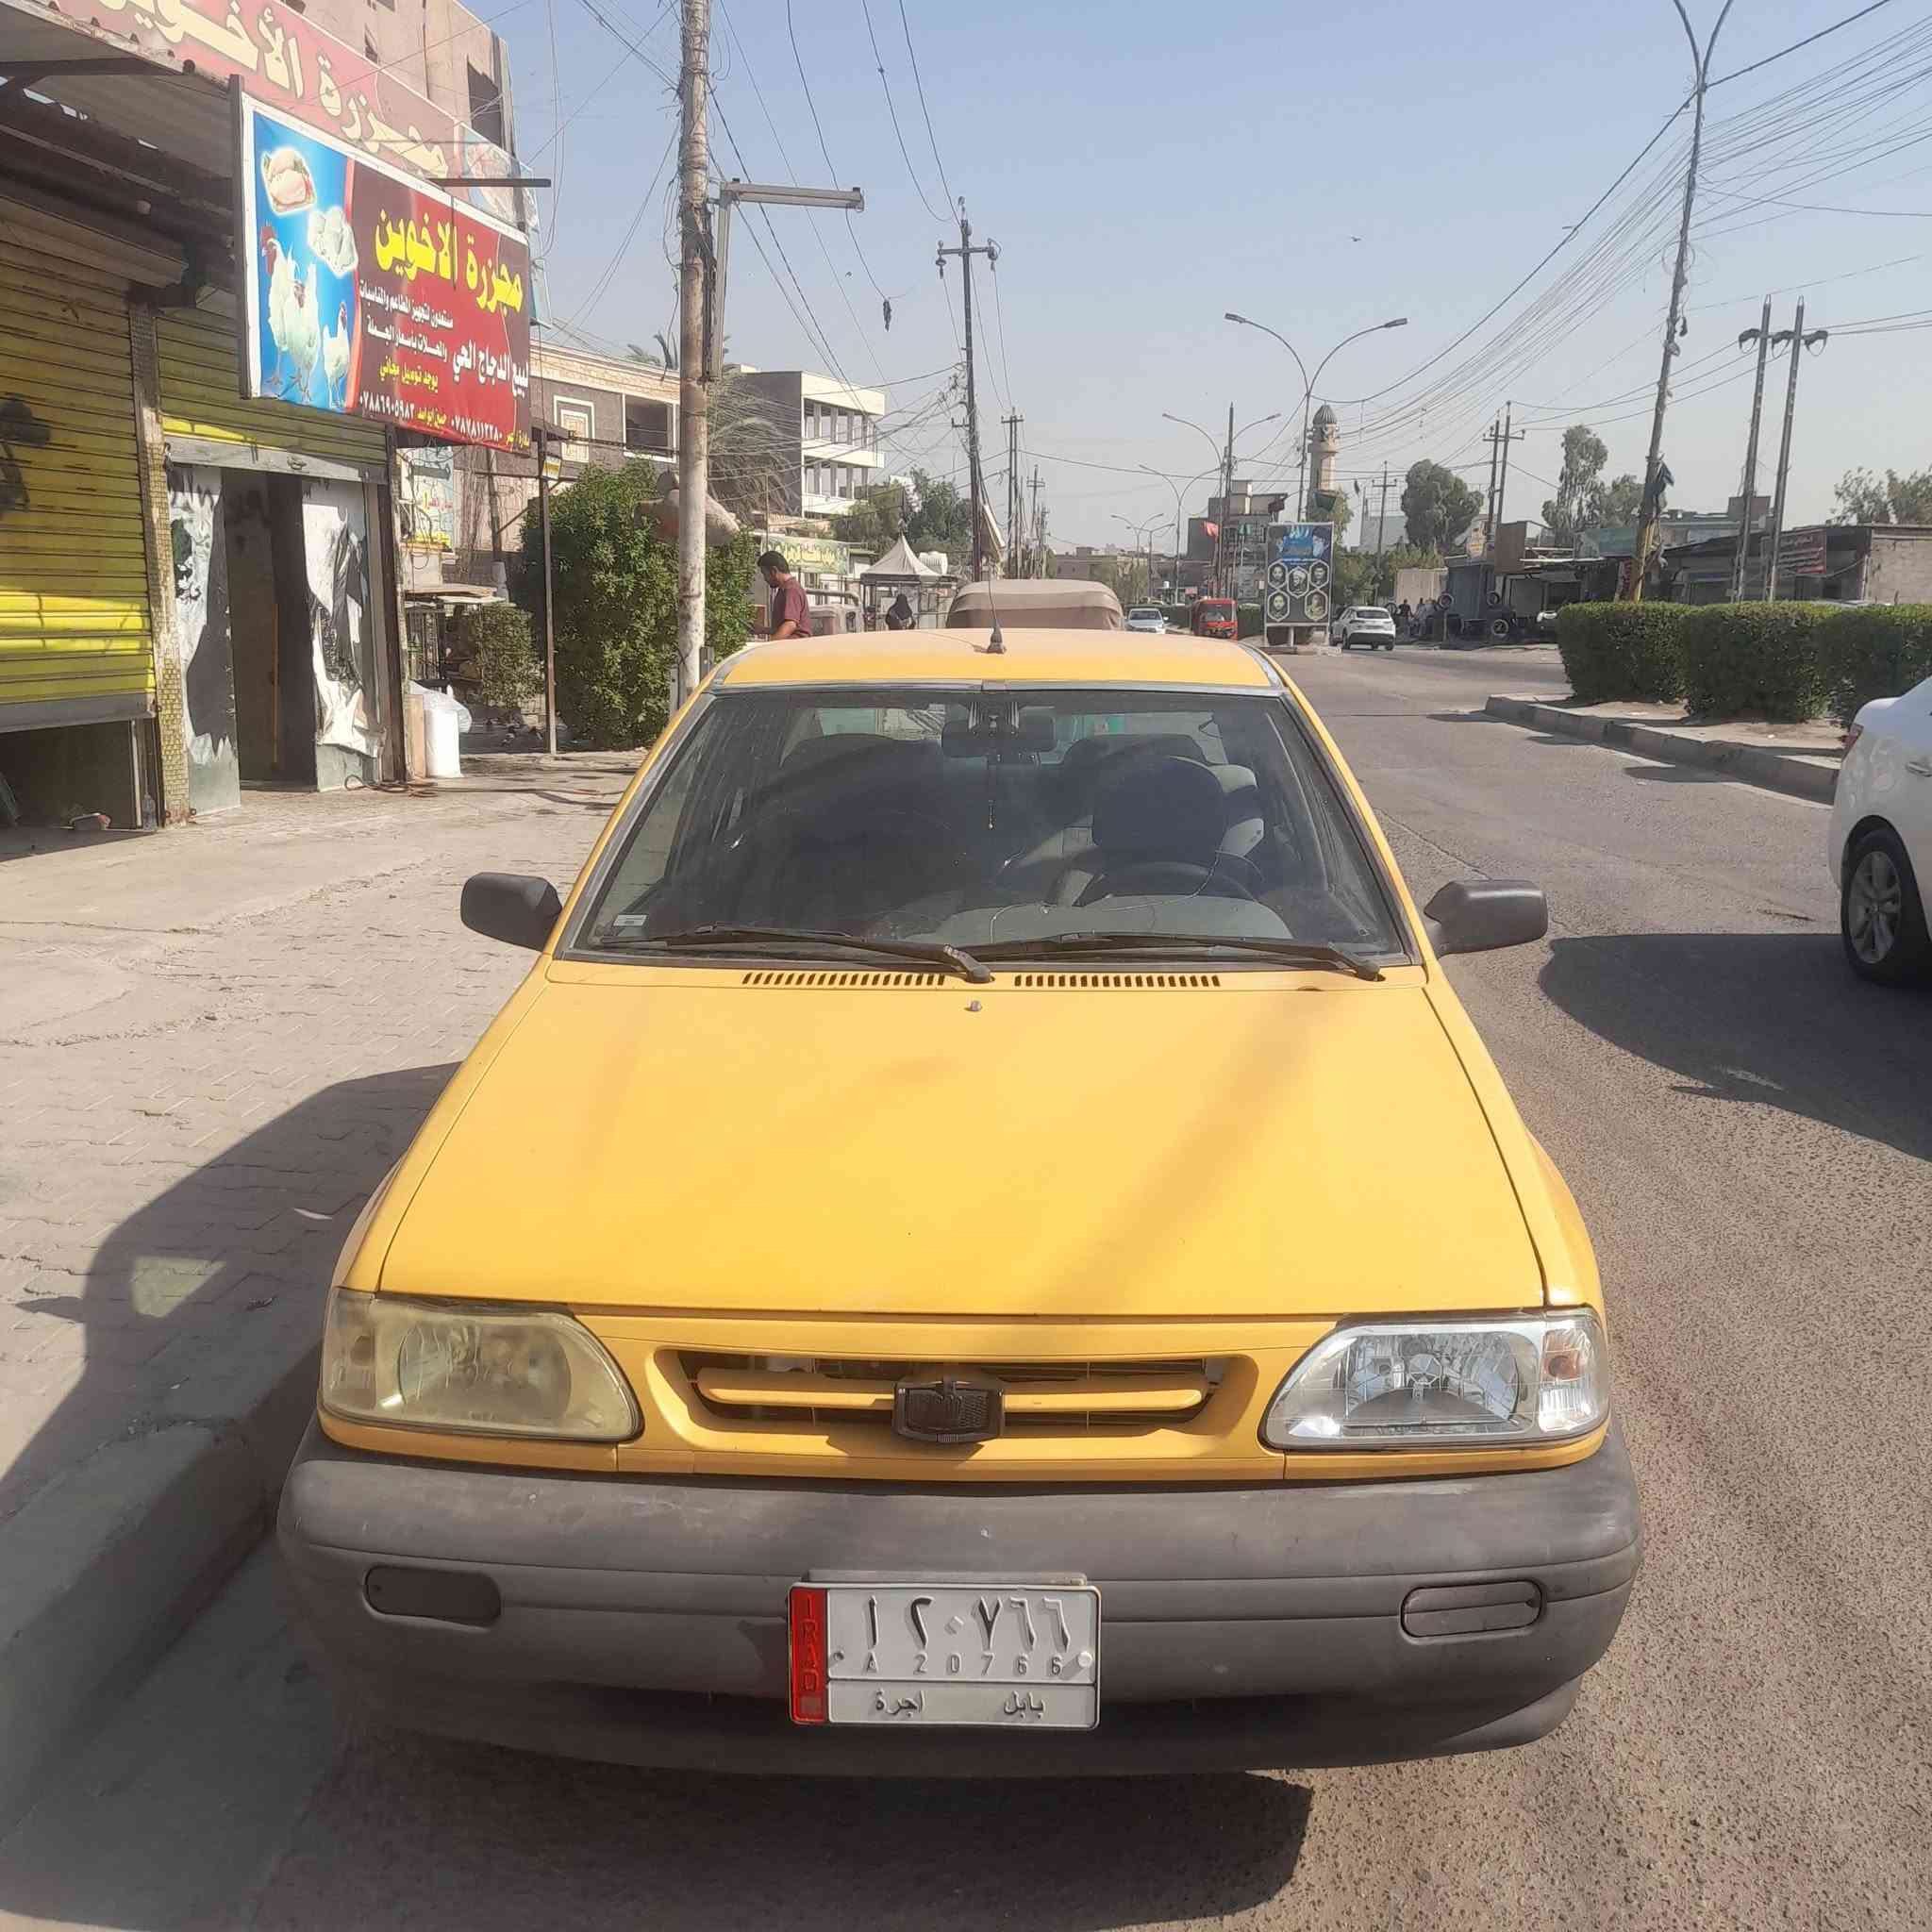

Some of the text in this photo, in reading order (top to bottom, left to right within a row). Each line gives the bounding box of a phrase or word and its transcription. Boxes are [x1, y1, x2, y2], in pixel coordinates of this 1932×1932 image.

[97, 0, 449, 179] مجزرة الأخوي
[375, 208, 524, 318] مجزرة الاخوين
[379, 355, 439, 393] يوجد توصيل مجاني
[453, 339, 476, 383] الحي
[477, 344, 510, 386] الدجاج
[874, 1689, 1047, 1720] بابل اجرة
